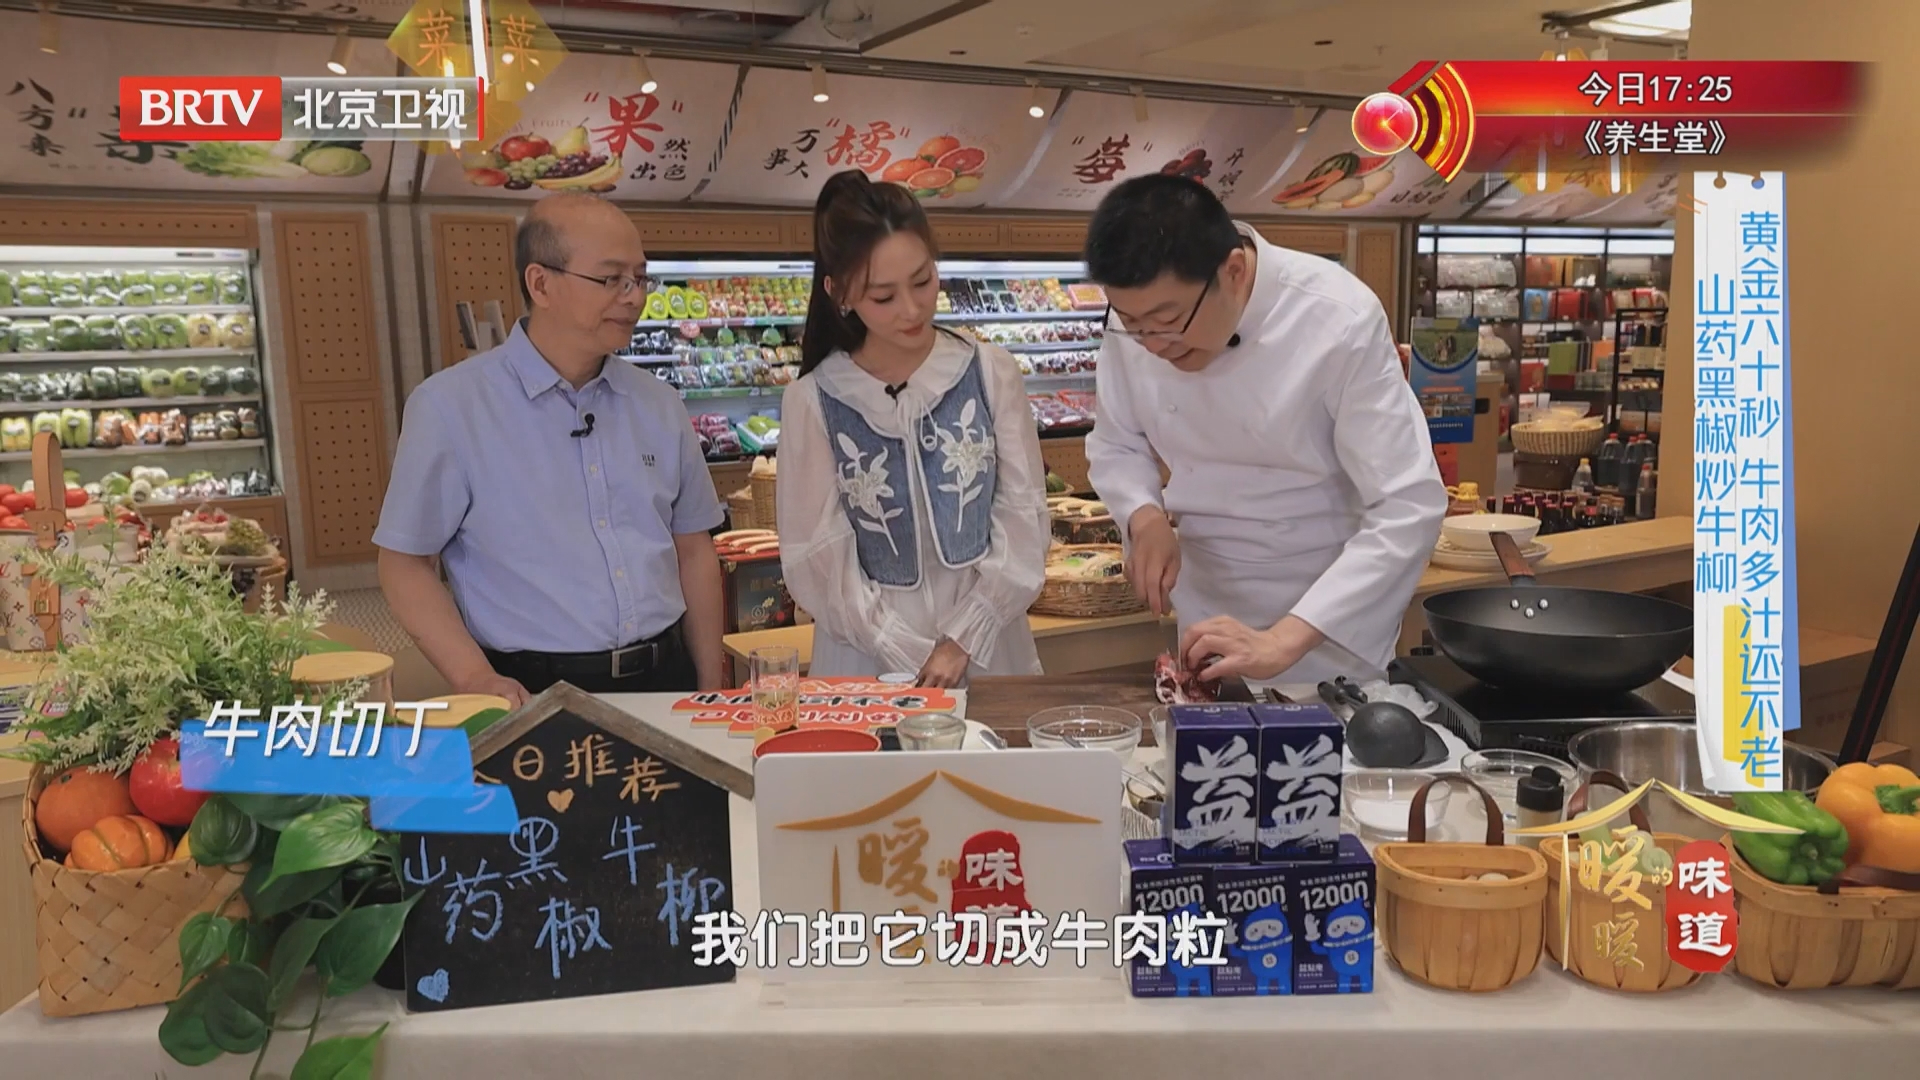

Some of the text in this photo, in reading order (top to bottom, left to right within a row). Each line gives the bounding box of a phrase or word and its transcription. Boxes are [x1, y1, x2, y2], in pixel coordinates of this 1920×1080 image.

[416, 8, 456, 69] 菜
[501, 13, 545, 73] 菜
[1135, 884, 1204, 913] 12000
[1217, 884, 1286, 914] 12000
[1300, 880, 1368, 911] 12000
